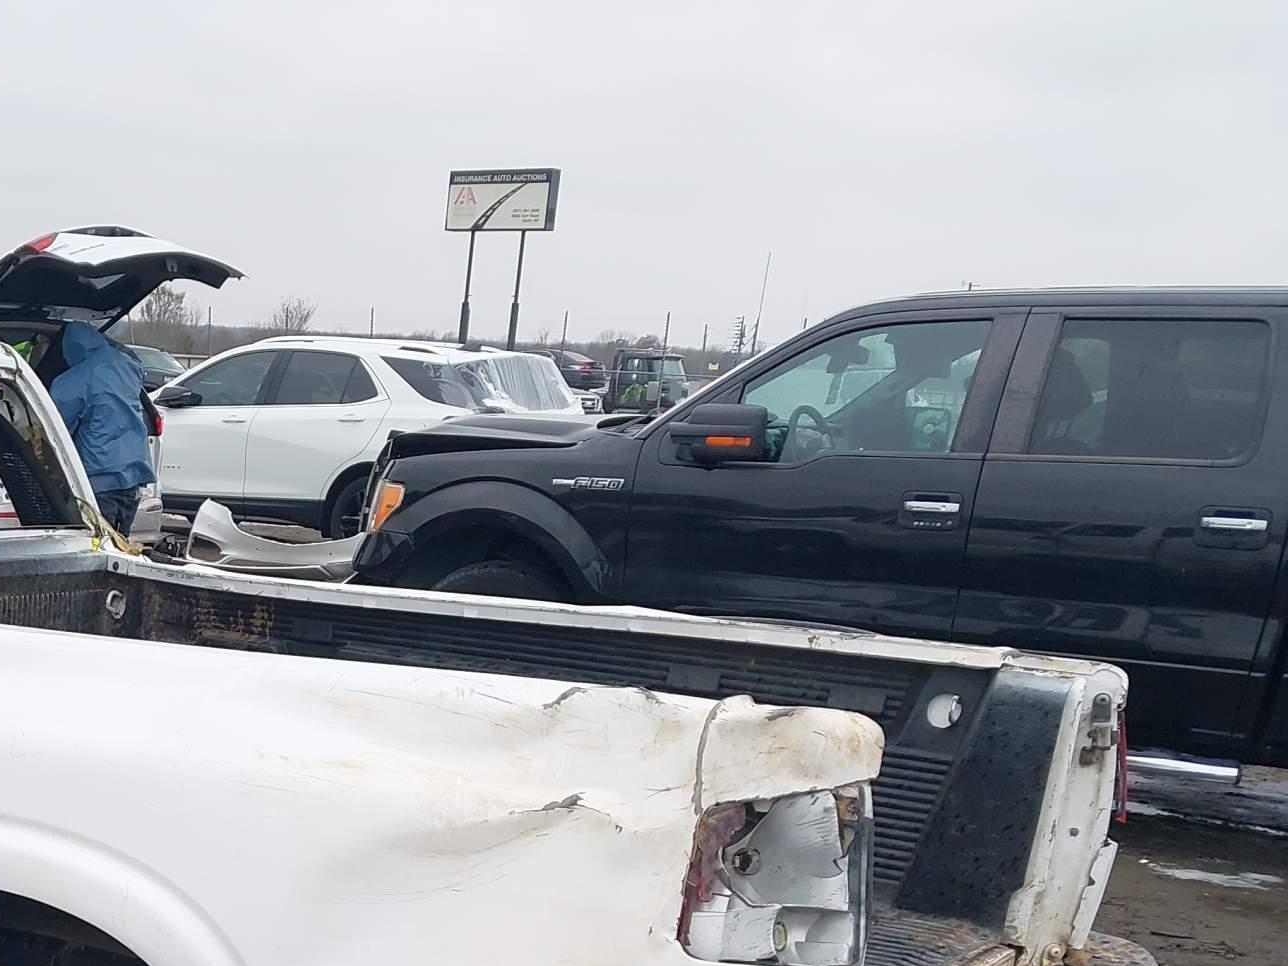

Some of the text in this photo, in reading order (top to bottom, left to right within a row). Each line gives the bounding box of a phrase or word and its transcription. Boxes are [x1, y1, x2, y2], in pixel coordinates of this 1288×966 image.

[454, 173, 547, 183] INSURANCE AUTO AUCTIONS
